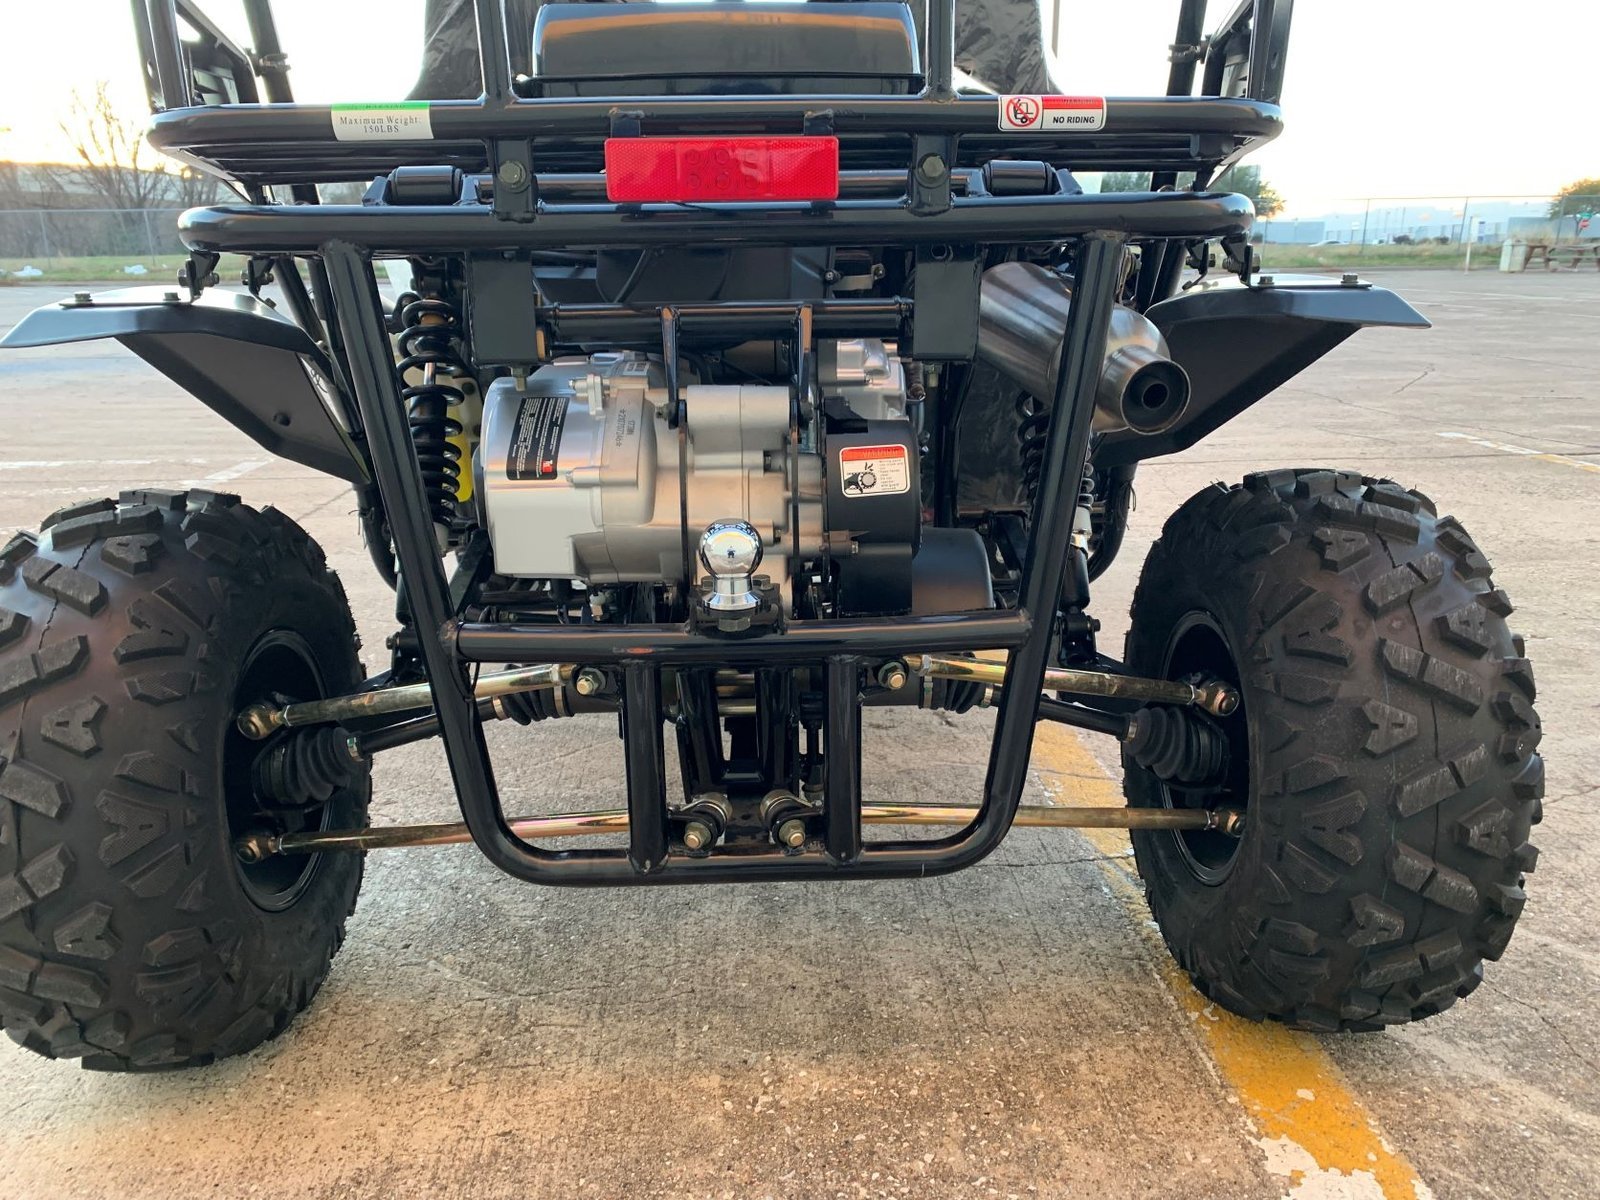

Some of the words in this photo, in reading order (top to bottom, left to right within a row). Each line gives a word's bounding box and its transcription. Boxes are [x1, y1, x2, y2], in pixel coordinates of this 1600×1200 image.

[340, 116, 384, 125] Maximum
[1052, 116, 1065, 124] NO
[1067, 116, 1095, 124] RIDING
[363, 125, 399, 133] 150LBS
